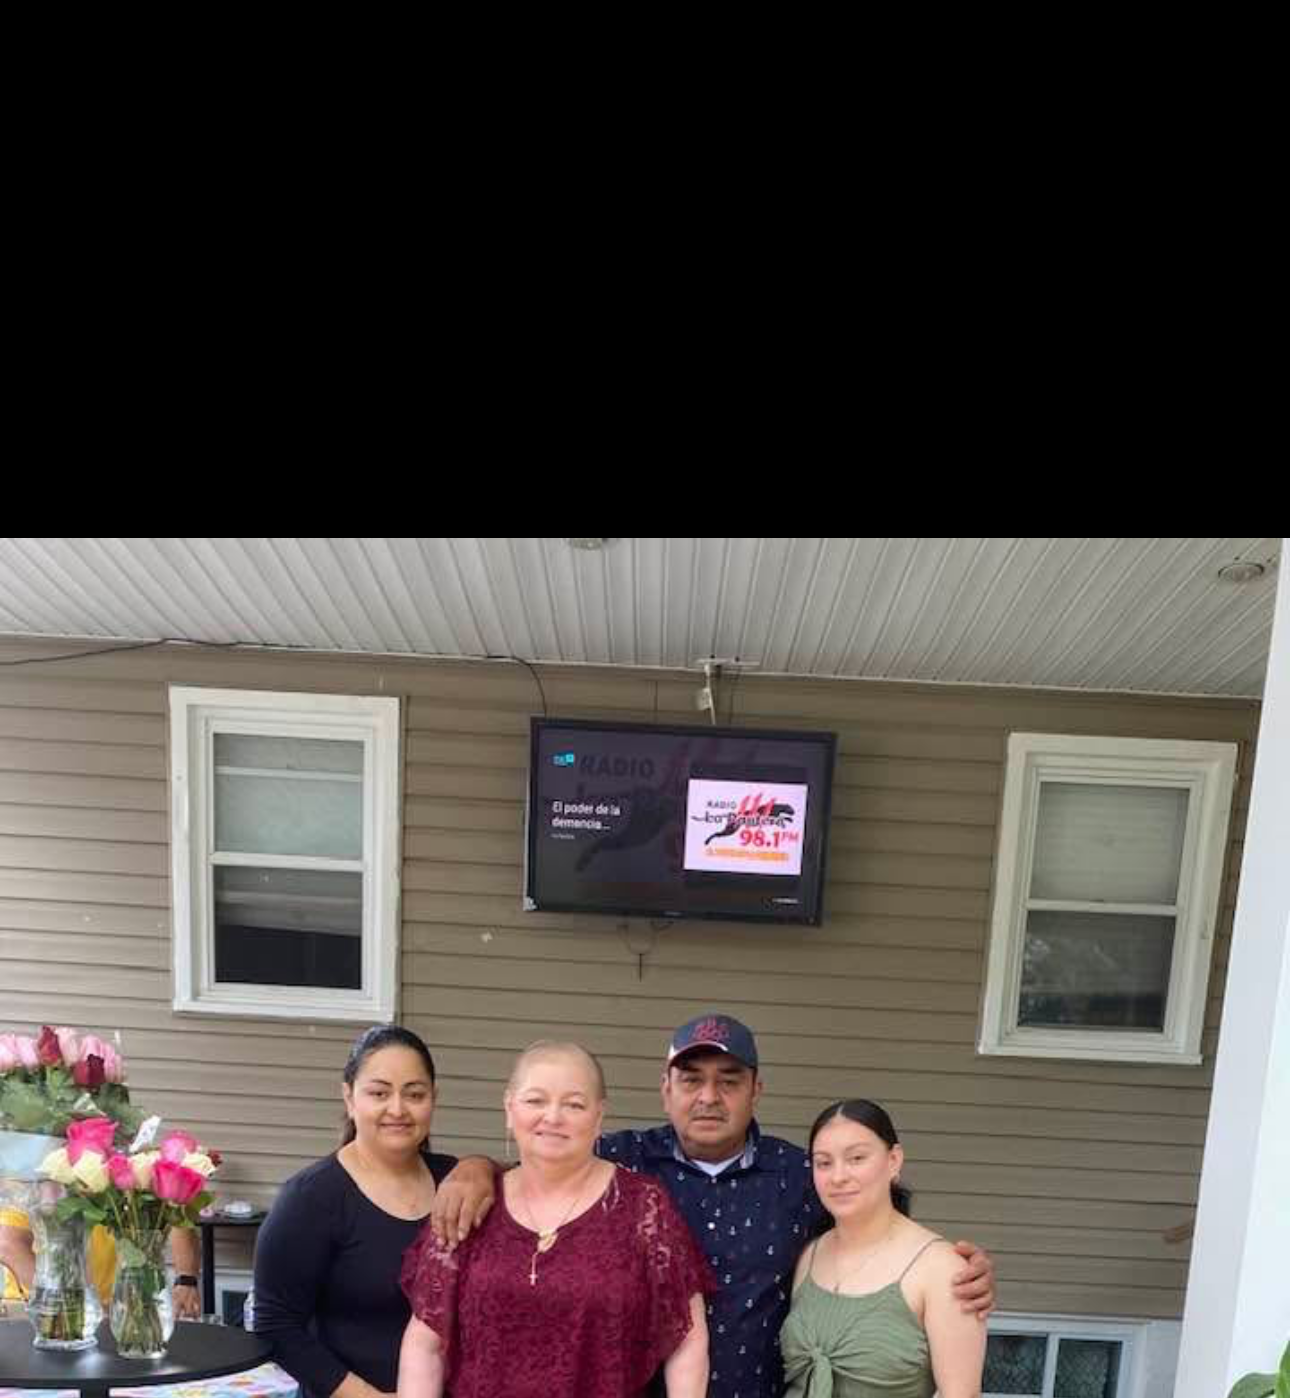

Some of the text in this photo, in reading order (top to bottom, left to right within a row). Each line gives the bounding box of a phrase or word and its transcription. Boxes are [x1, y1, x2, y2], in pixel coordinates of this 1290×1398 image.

[552, 800, 621, 816] El poder de la
[706, 800, 737, 810] RADIO
